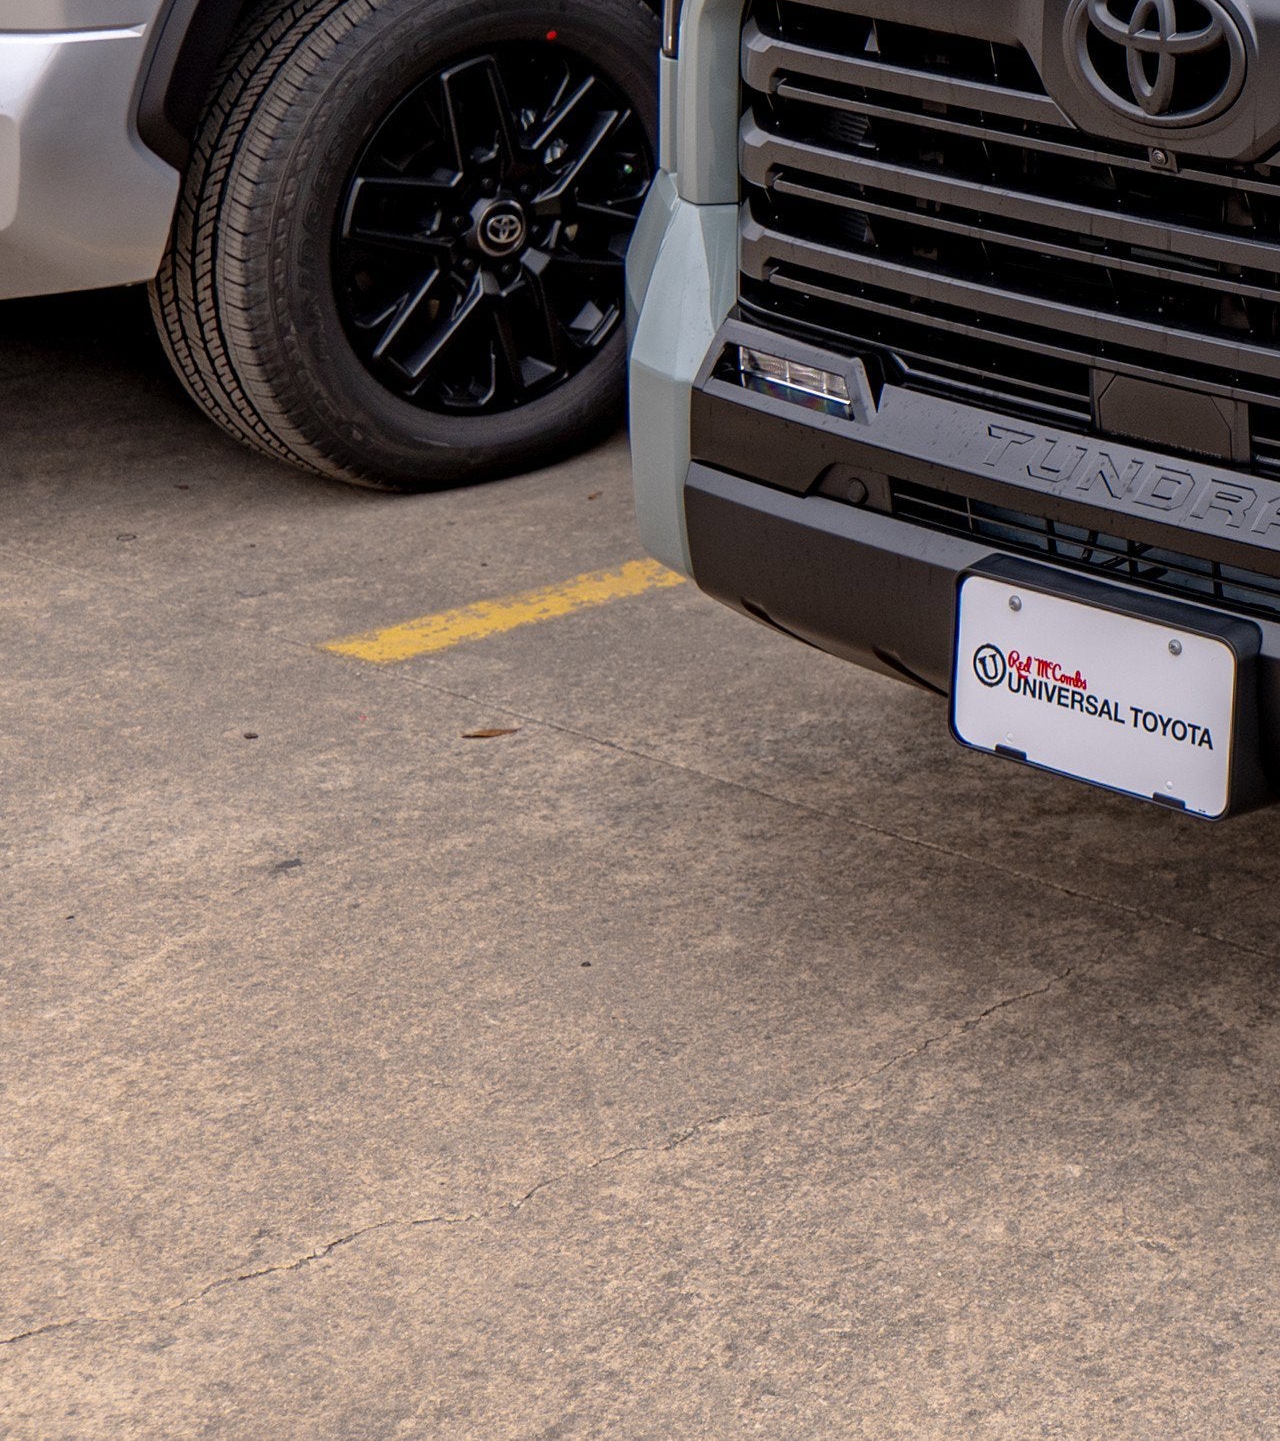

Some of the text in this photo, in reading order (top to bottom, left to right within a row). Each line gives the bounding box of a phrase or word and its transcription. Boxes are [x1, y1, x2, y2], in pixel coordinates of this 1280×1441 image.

[1008, 650, 1087, 690] Red McCombs
[1007, 672, 1214, 750] UNIVERSAL TOYOTA
